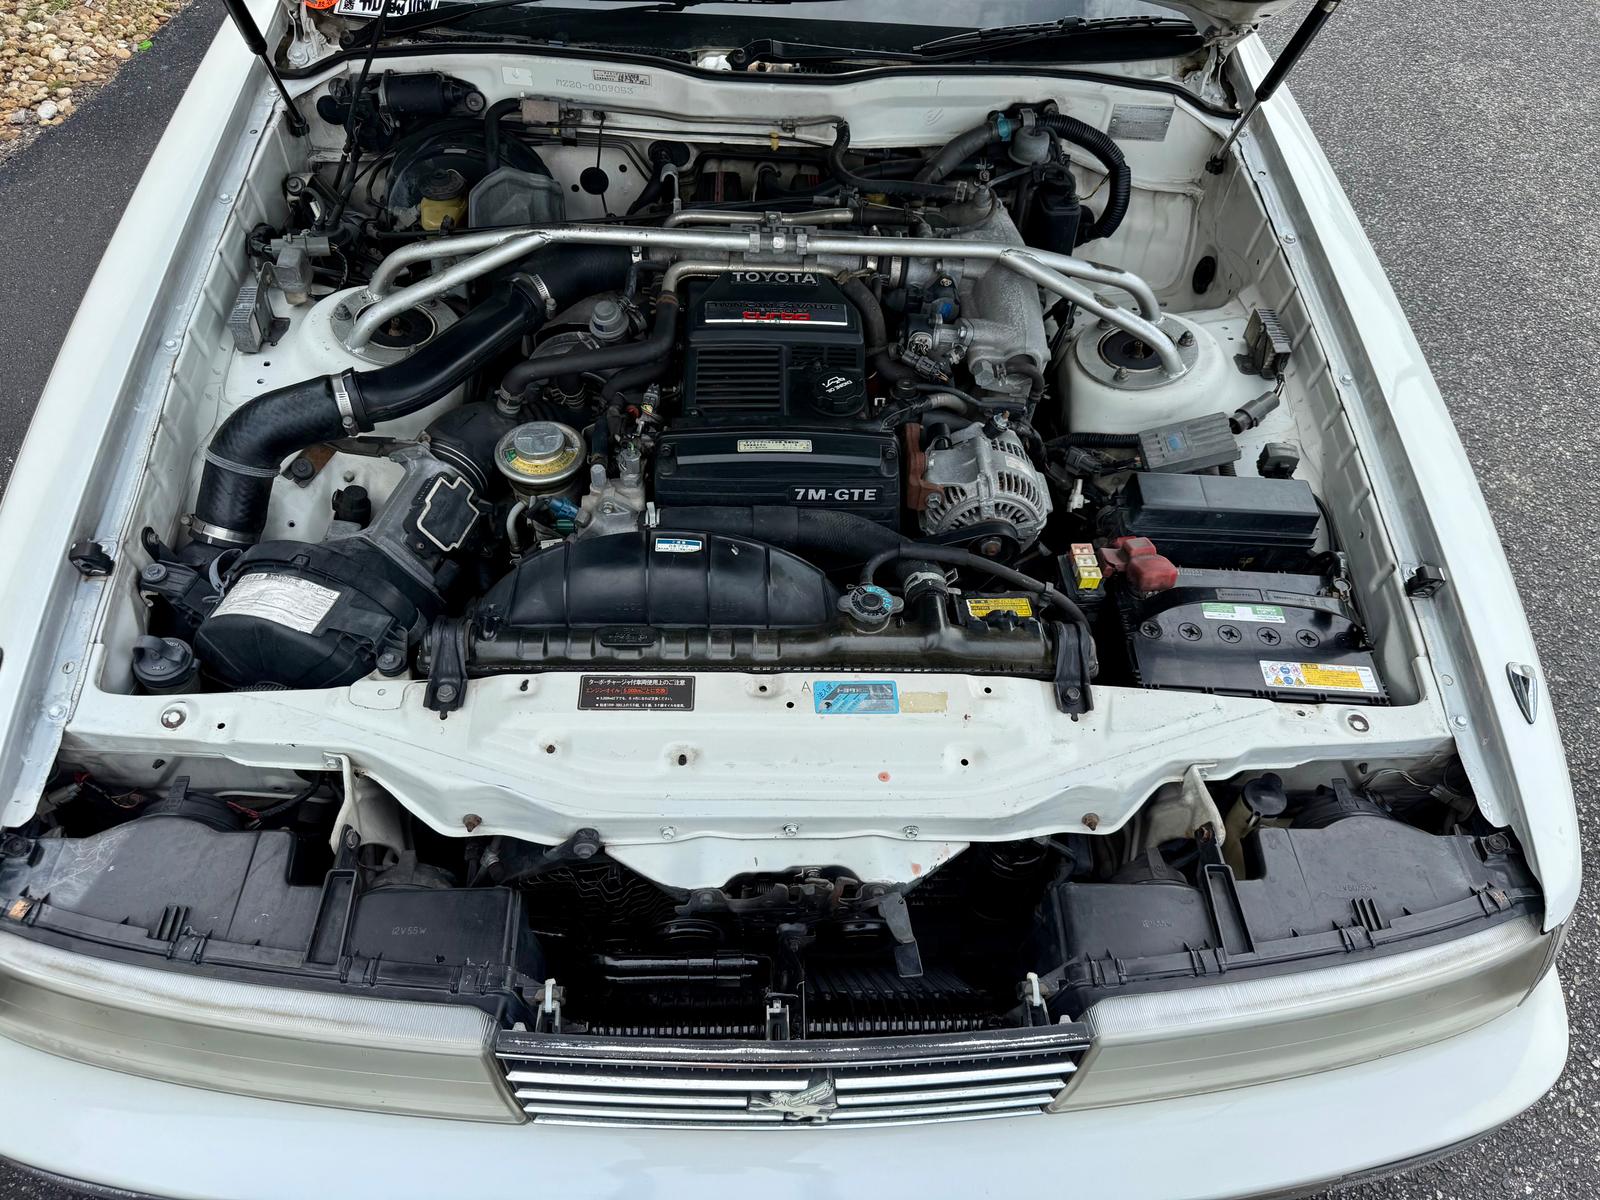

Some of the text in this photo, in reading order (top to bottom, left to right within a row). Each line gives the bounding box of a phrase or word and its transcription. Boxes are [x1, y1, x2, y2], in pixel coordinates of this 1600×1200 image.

[732, 272, 817, 284] TOYOTA
[742, 311, 811, 320] turbo
[794, 488, 877, 501] 7M-GTE
[801, 681, 811, 692] A
